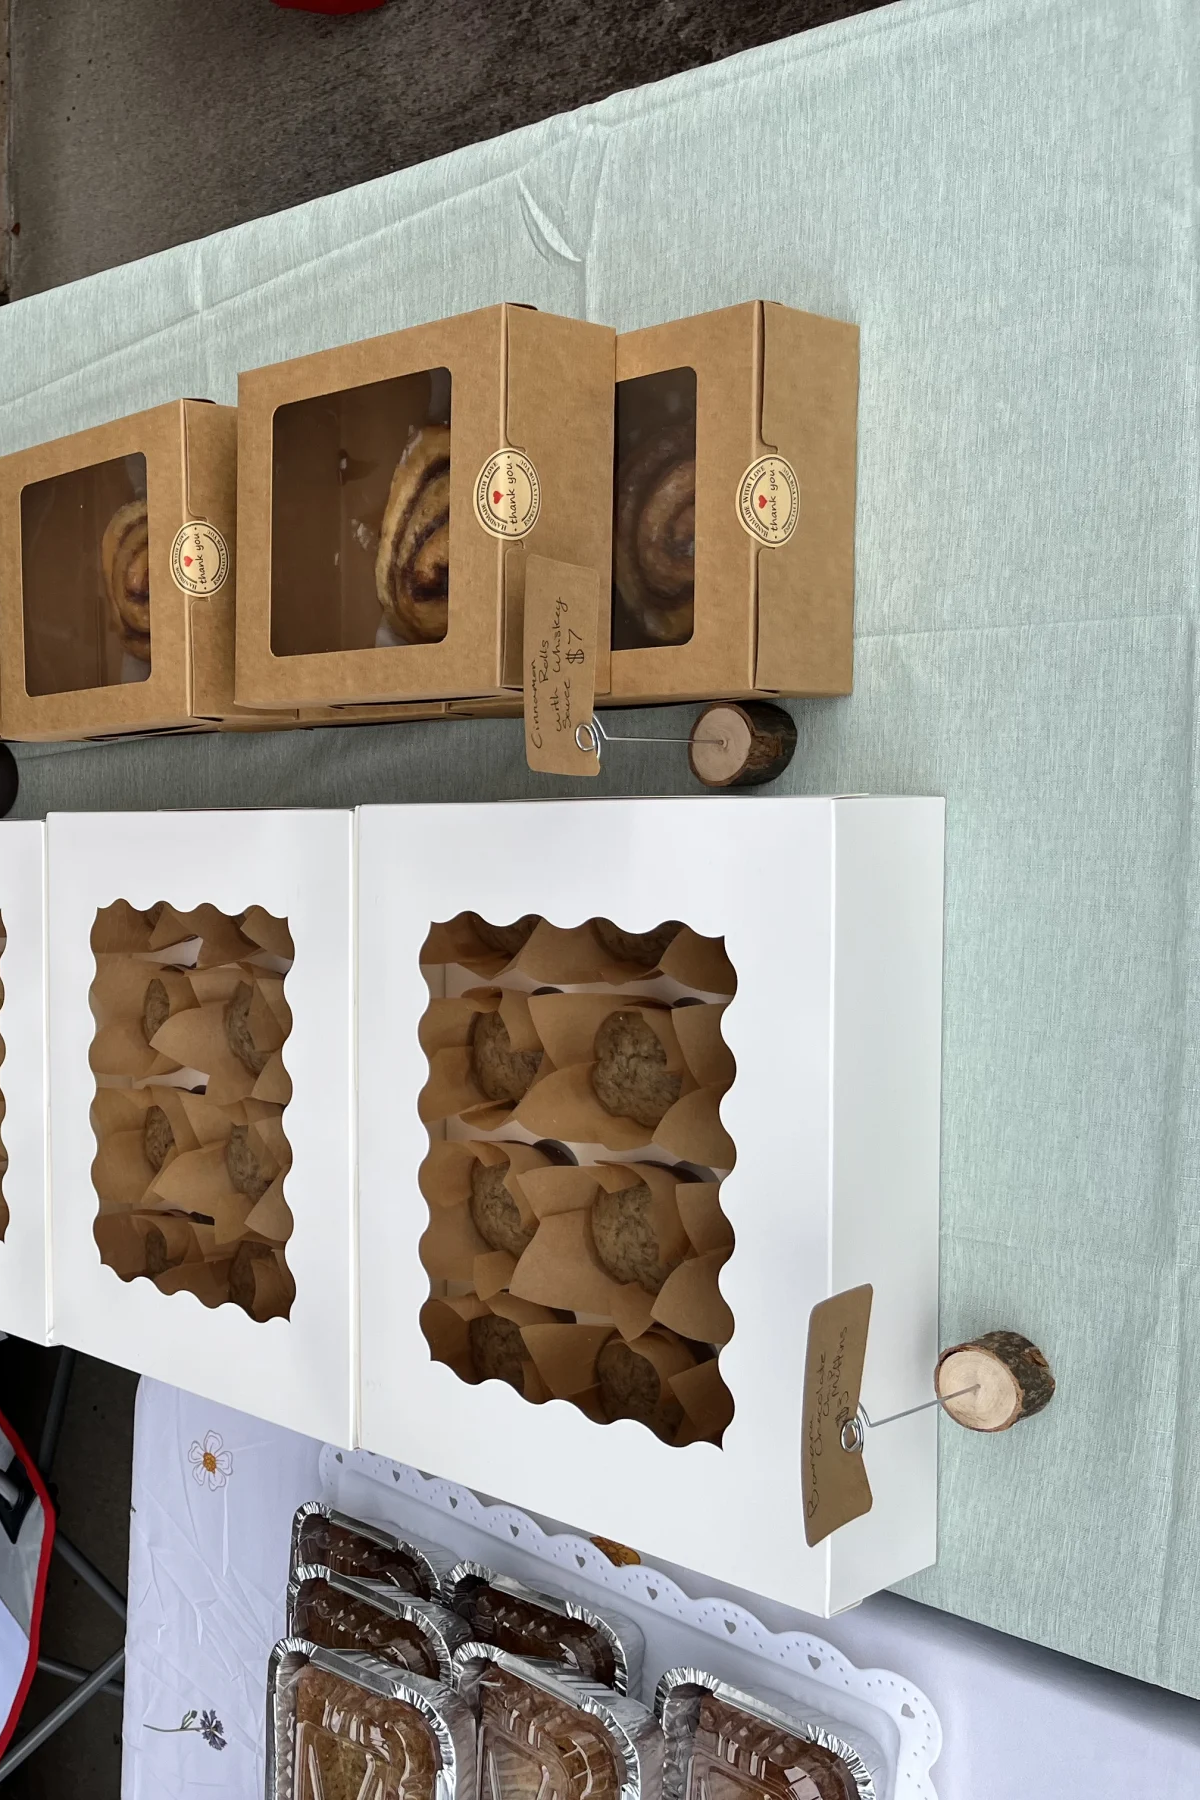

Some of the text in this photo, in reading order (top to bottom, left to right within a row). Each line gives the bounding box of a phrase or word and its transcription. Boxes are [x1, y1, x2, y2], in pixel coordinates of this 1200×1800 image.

[506, 463, 518, 524] thank you
[769, 470, 778, 532] thank you
[194, 533, 207, 584] thank you
[539, 640, 549, 684] Rolls
[531, 660, 542, 749] Cinnamon
[550, 687, 562, 732] with
[806, 1414, 820, 1518] Banana
